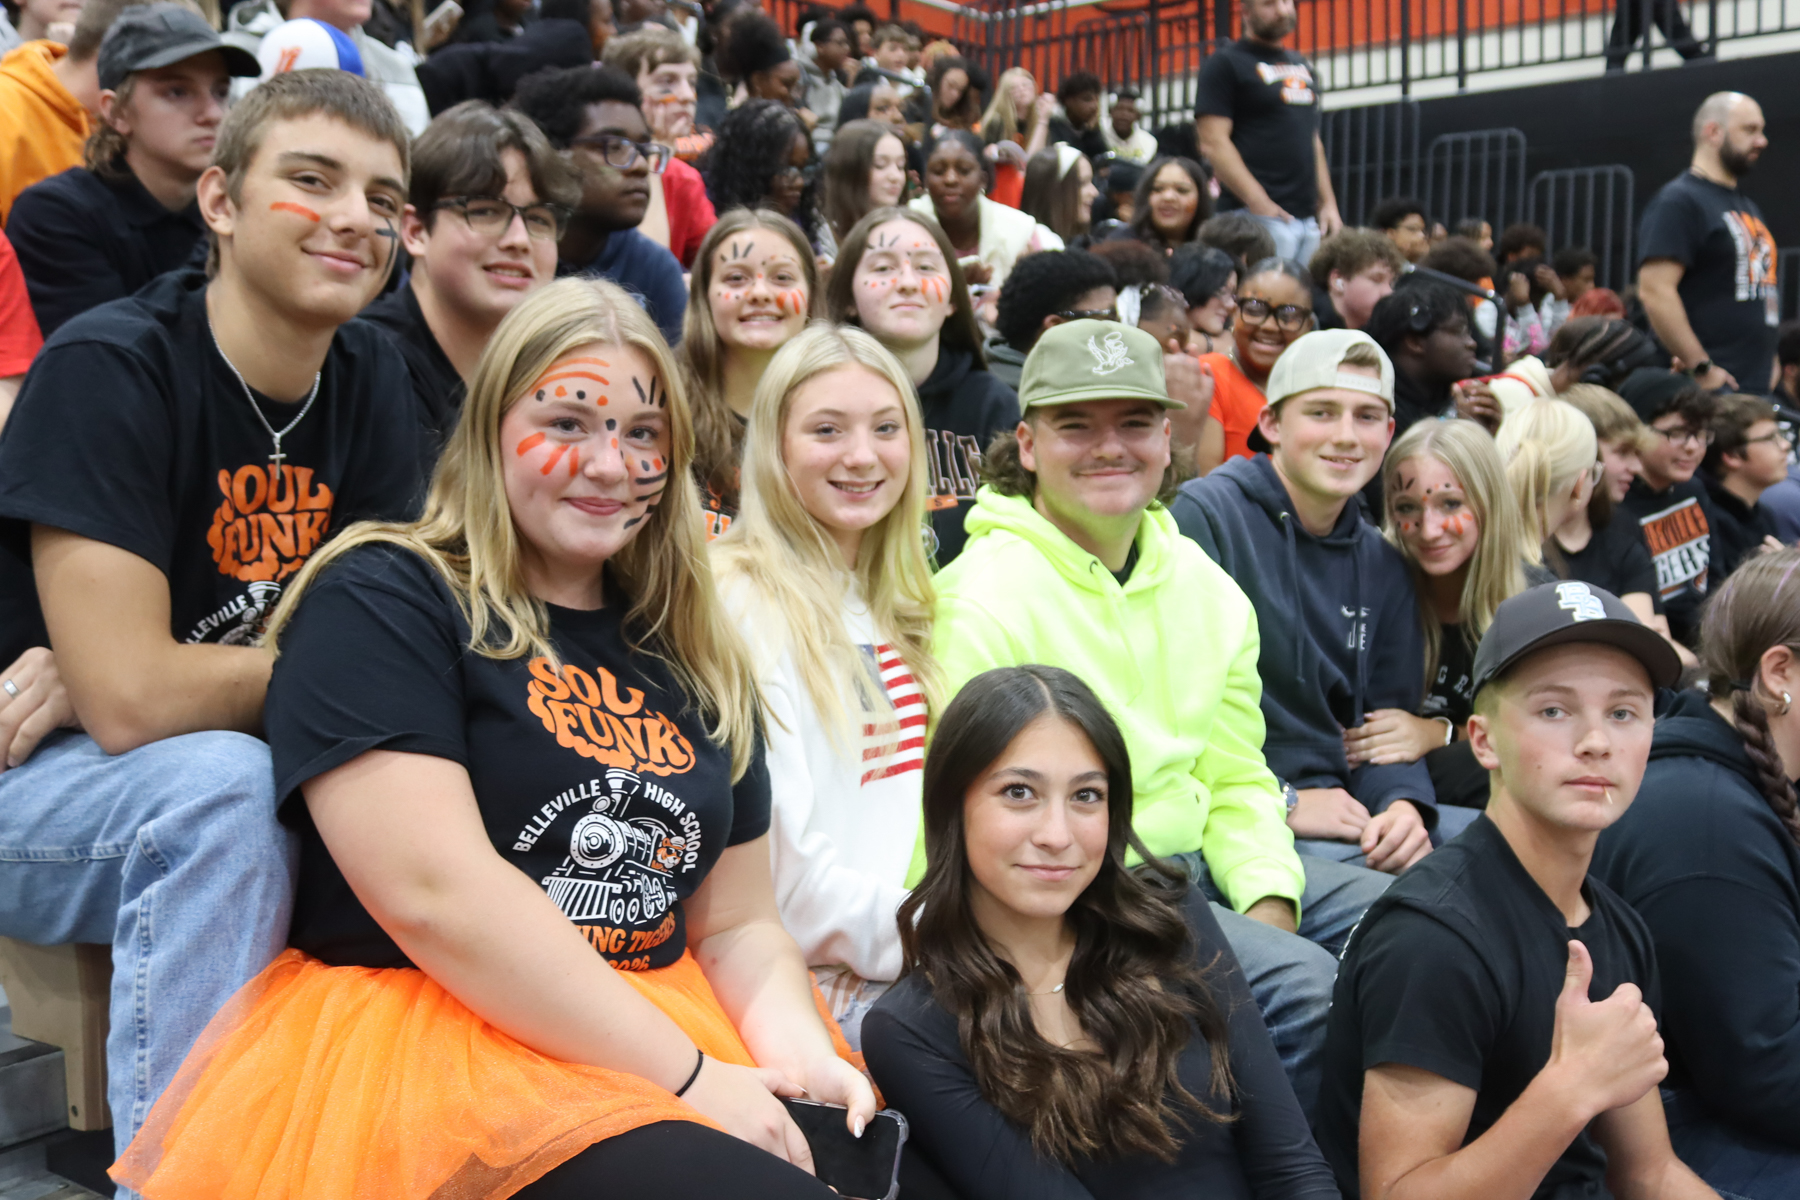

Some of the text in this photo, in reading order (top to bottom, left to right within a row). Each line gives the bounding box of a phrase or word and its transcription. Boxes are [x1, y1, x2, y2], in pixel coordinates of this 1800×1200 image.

[217, 463, 331, 523] SOUL
[222, 511, 328, 565] FUNK
[546, 699, 690, 766] FUNK
[512, 779, 701, 873] BELLEVILLE HIGH SCHOOL
